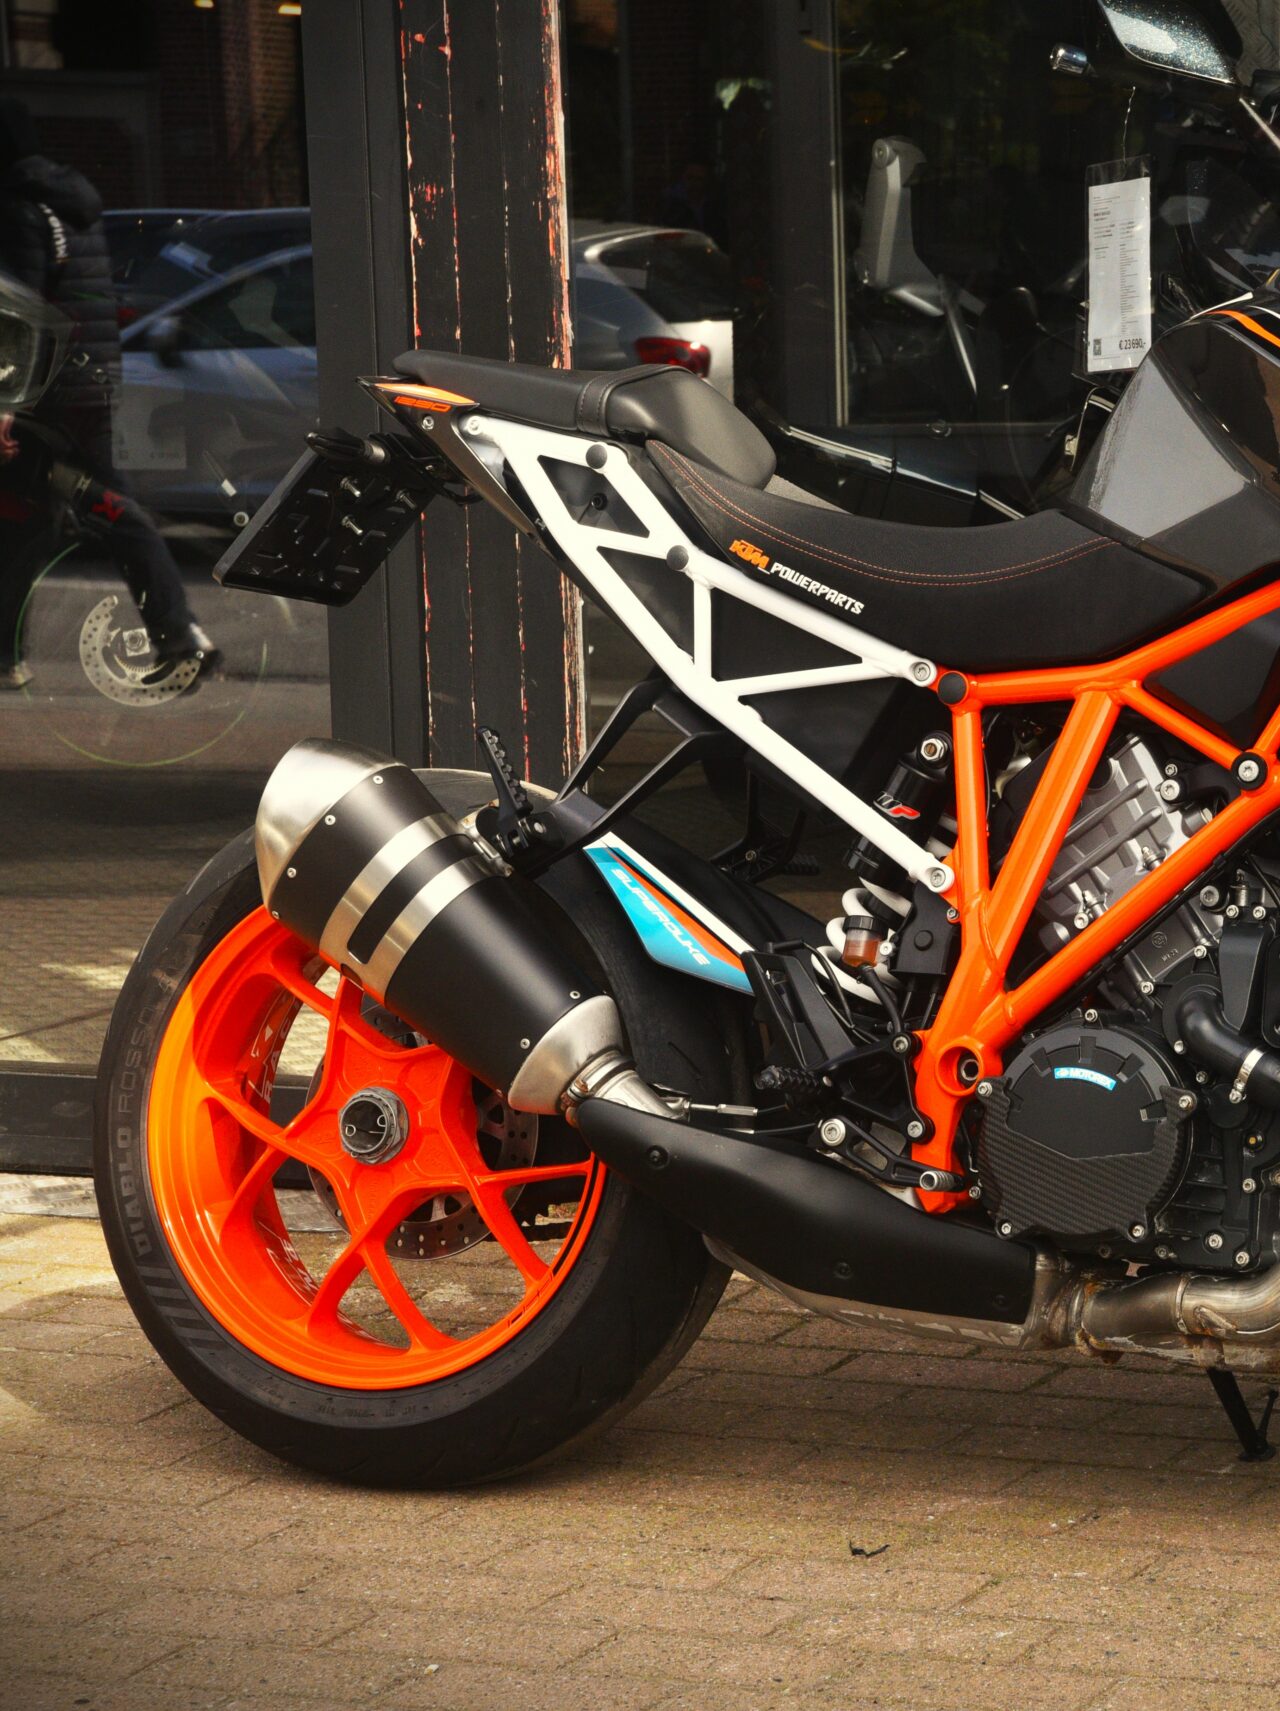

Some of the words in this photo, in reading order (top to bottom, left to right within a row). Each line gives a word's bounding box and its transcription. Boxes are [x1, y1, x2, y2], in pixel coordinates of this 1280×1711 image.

[729, 539, 770, 569] KTM
[770, 562, 865, 614] POWERPARTS
[611, 868, 710, 965] SUPERDUKE
[116, 1125, 153, 1257] DIABLO
